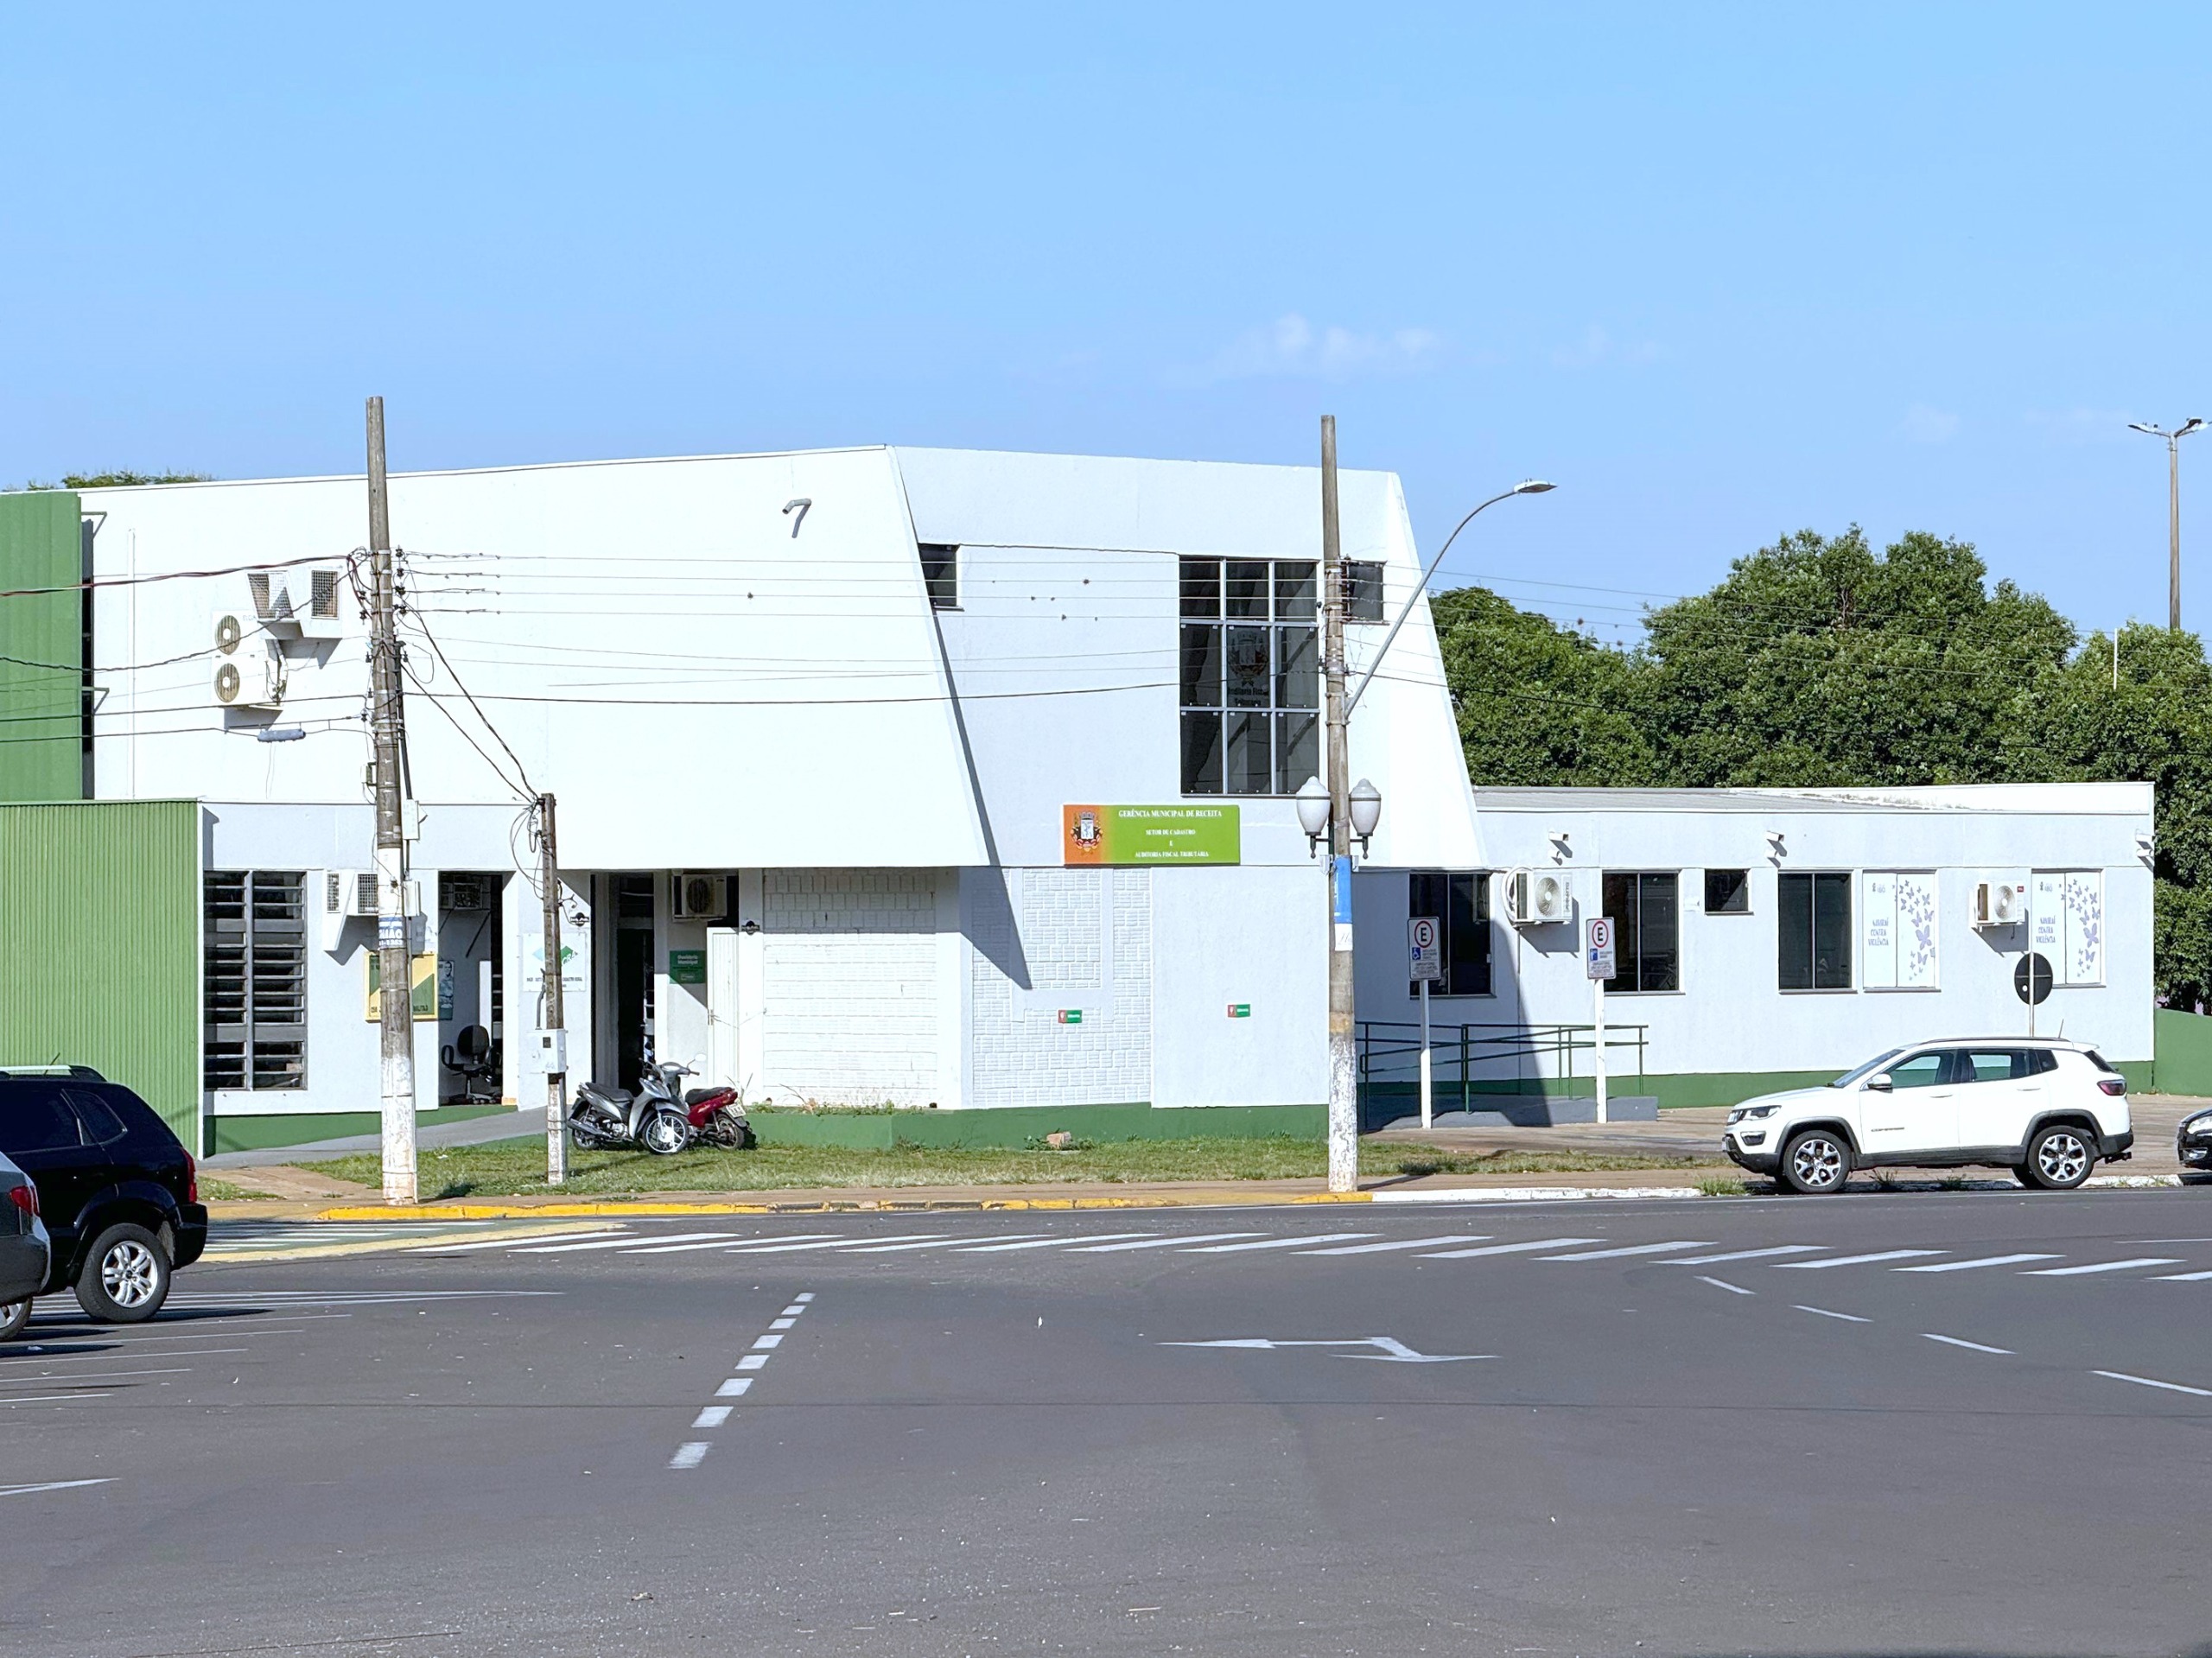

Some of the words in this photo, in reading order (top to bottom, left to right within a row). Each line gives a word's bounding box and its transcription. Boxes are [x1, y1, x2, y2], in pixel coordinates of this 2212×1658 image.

[1118, 809, 1150, 817] GERÊNCIA
[1421, 927, 1427, 942] E
[1597, 927, 1604, 941] E
